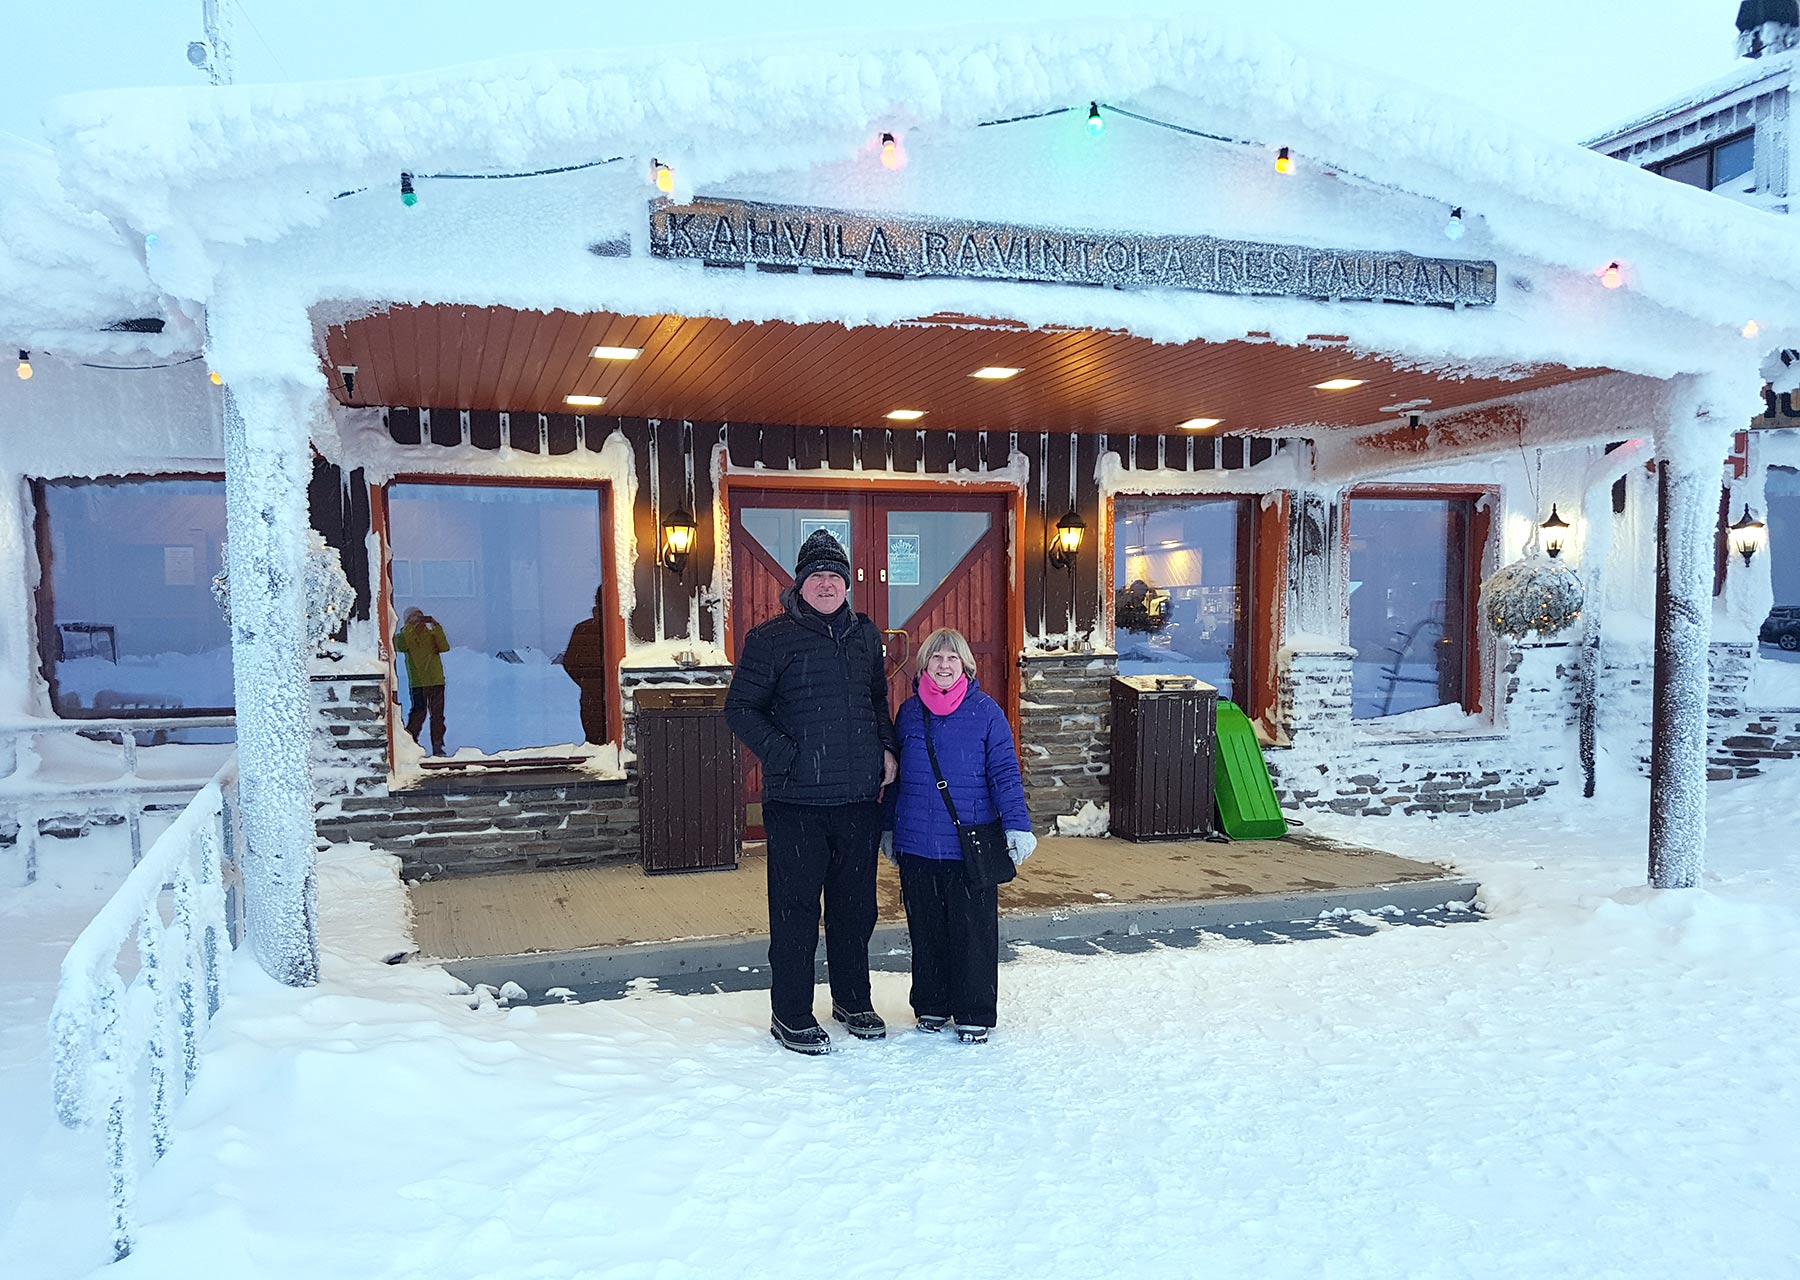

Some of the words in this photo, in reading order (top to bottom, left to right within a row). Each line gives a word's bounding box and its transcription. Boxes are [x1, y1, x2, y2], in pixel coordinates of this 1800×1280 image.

[666, 212, 893, 266] KAHVILA
[920, 231, 1187, 282] RAVINTOLA
[1213, 248, 1484, 296] RESTAURANT
